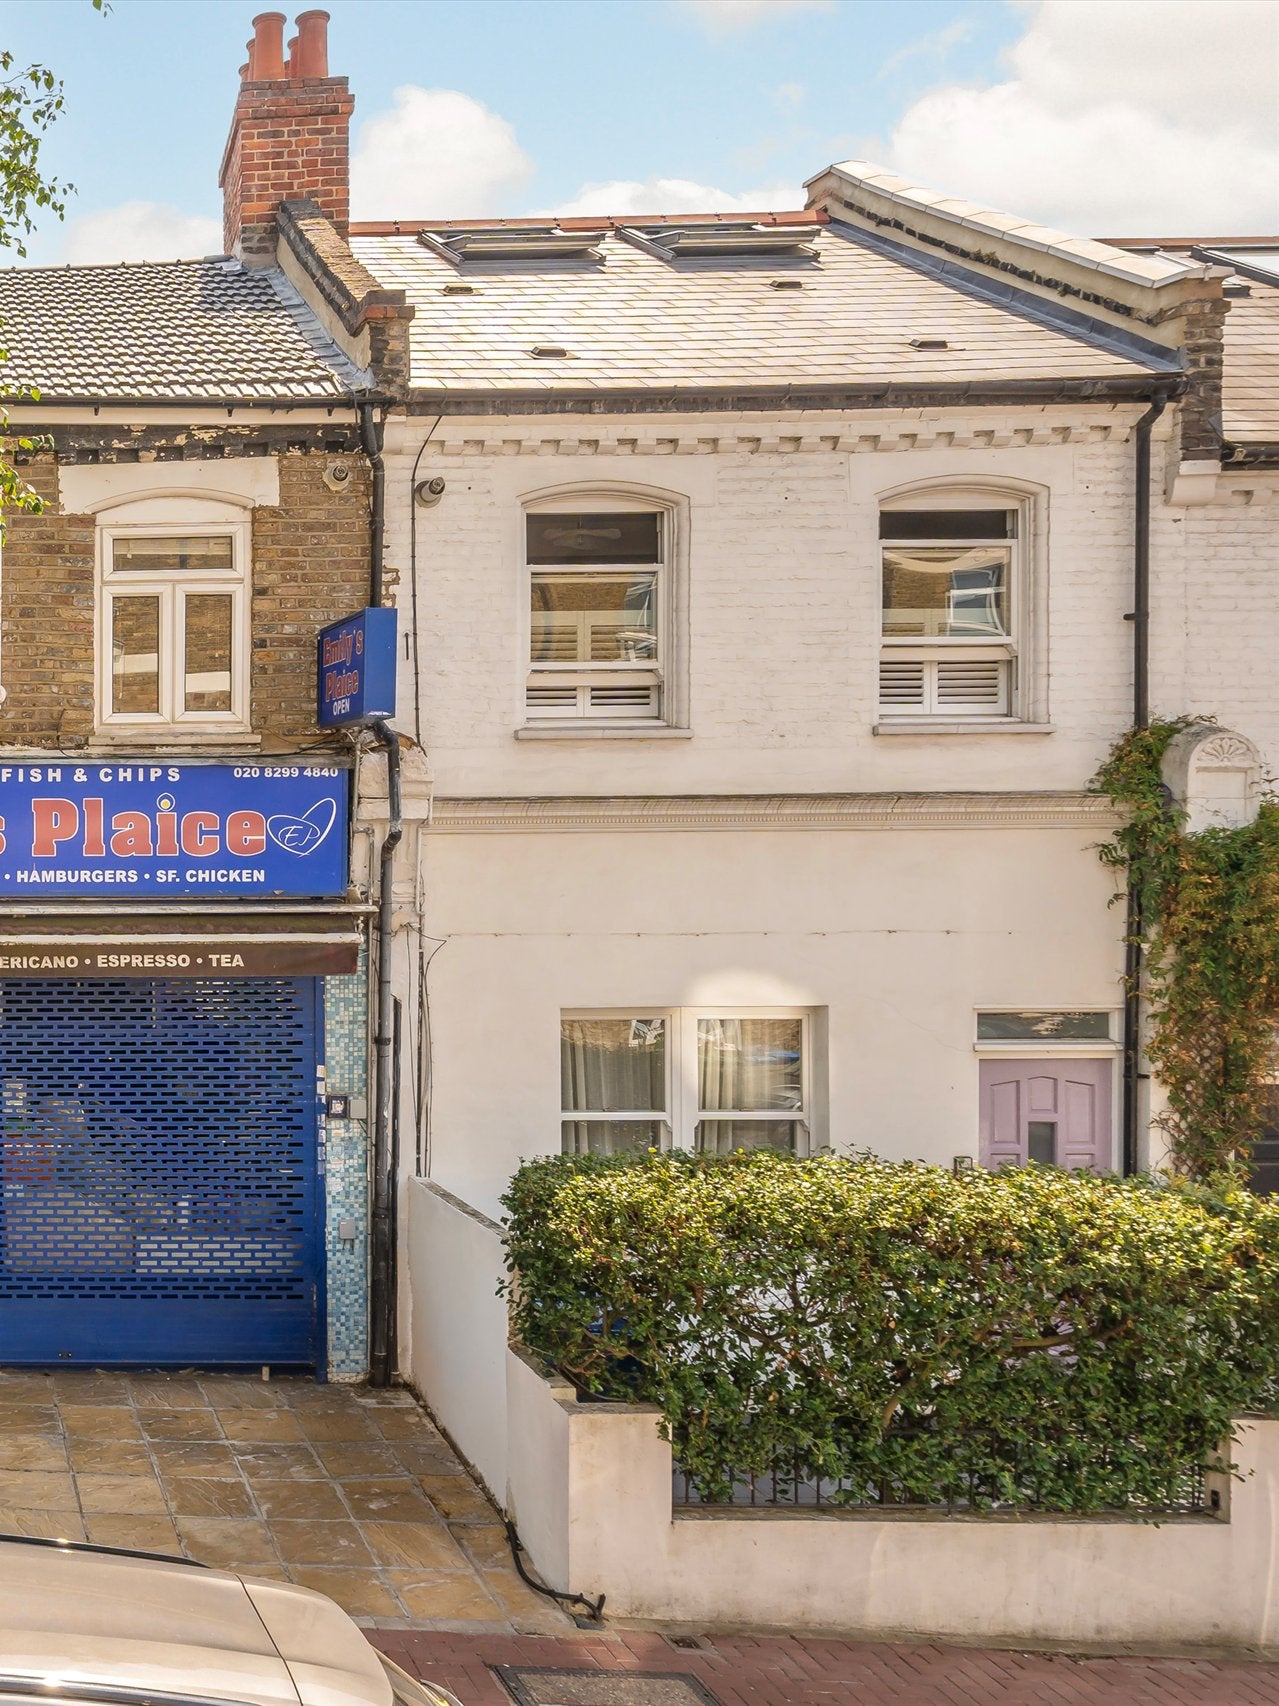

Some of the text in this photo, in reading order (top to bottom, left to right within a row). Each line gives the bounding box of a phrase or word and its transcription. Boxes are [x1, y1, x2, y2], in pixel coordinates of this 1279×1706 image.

[323, 629, 363, 667] Emily's
[326, 669, 358, 702] Plaice
[333, 698, 350, 716] OPEN
[1, 768, 62, 783] FISH
[73, 768, 89, 783] &
[98, 768, 181, 783] CHIPS
[233, 767, 339, 779] 020 8299 4840
[31, 792, 266, 858] Plaice
[16, 869, 138, 884] HAMBURGERS
[155, 869, 181, 883] SF.
[185, 869, 265, 883] CHICKEN
[97, 954, 191, 968] ESPRESSO
[208, 954, 245, 967] TEA
